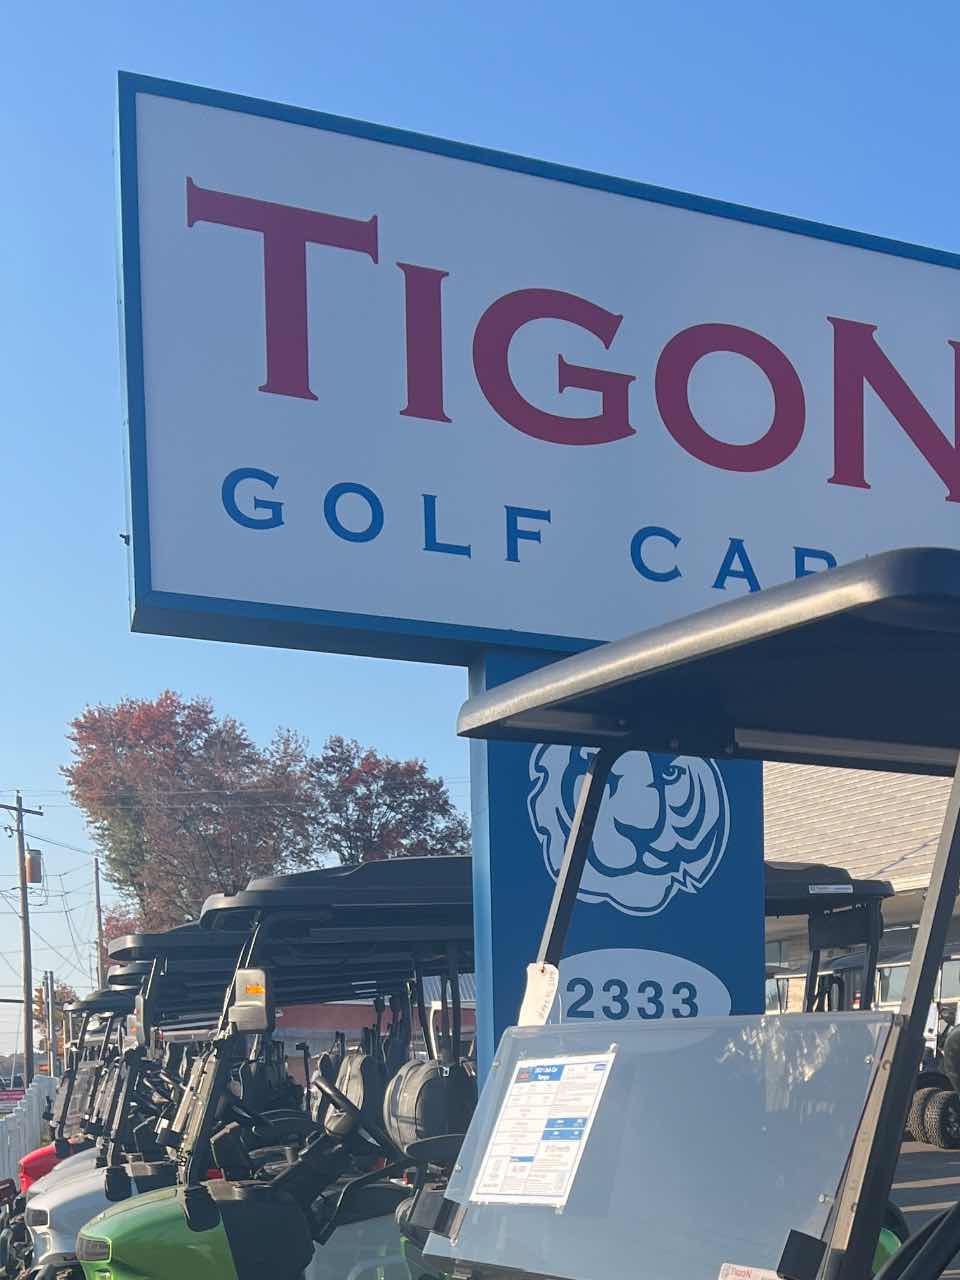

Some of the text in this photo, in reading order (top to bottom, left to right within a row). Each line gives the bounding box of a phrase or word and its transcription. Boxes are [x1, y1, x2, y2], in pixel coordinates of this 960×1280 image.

[221, 467, 886, 592] GOLF CAR
[566, 977, 698, 1020] 2333
